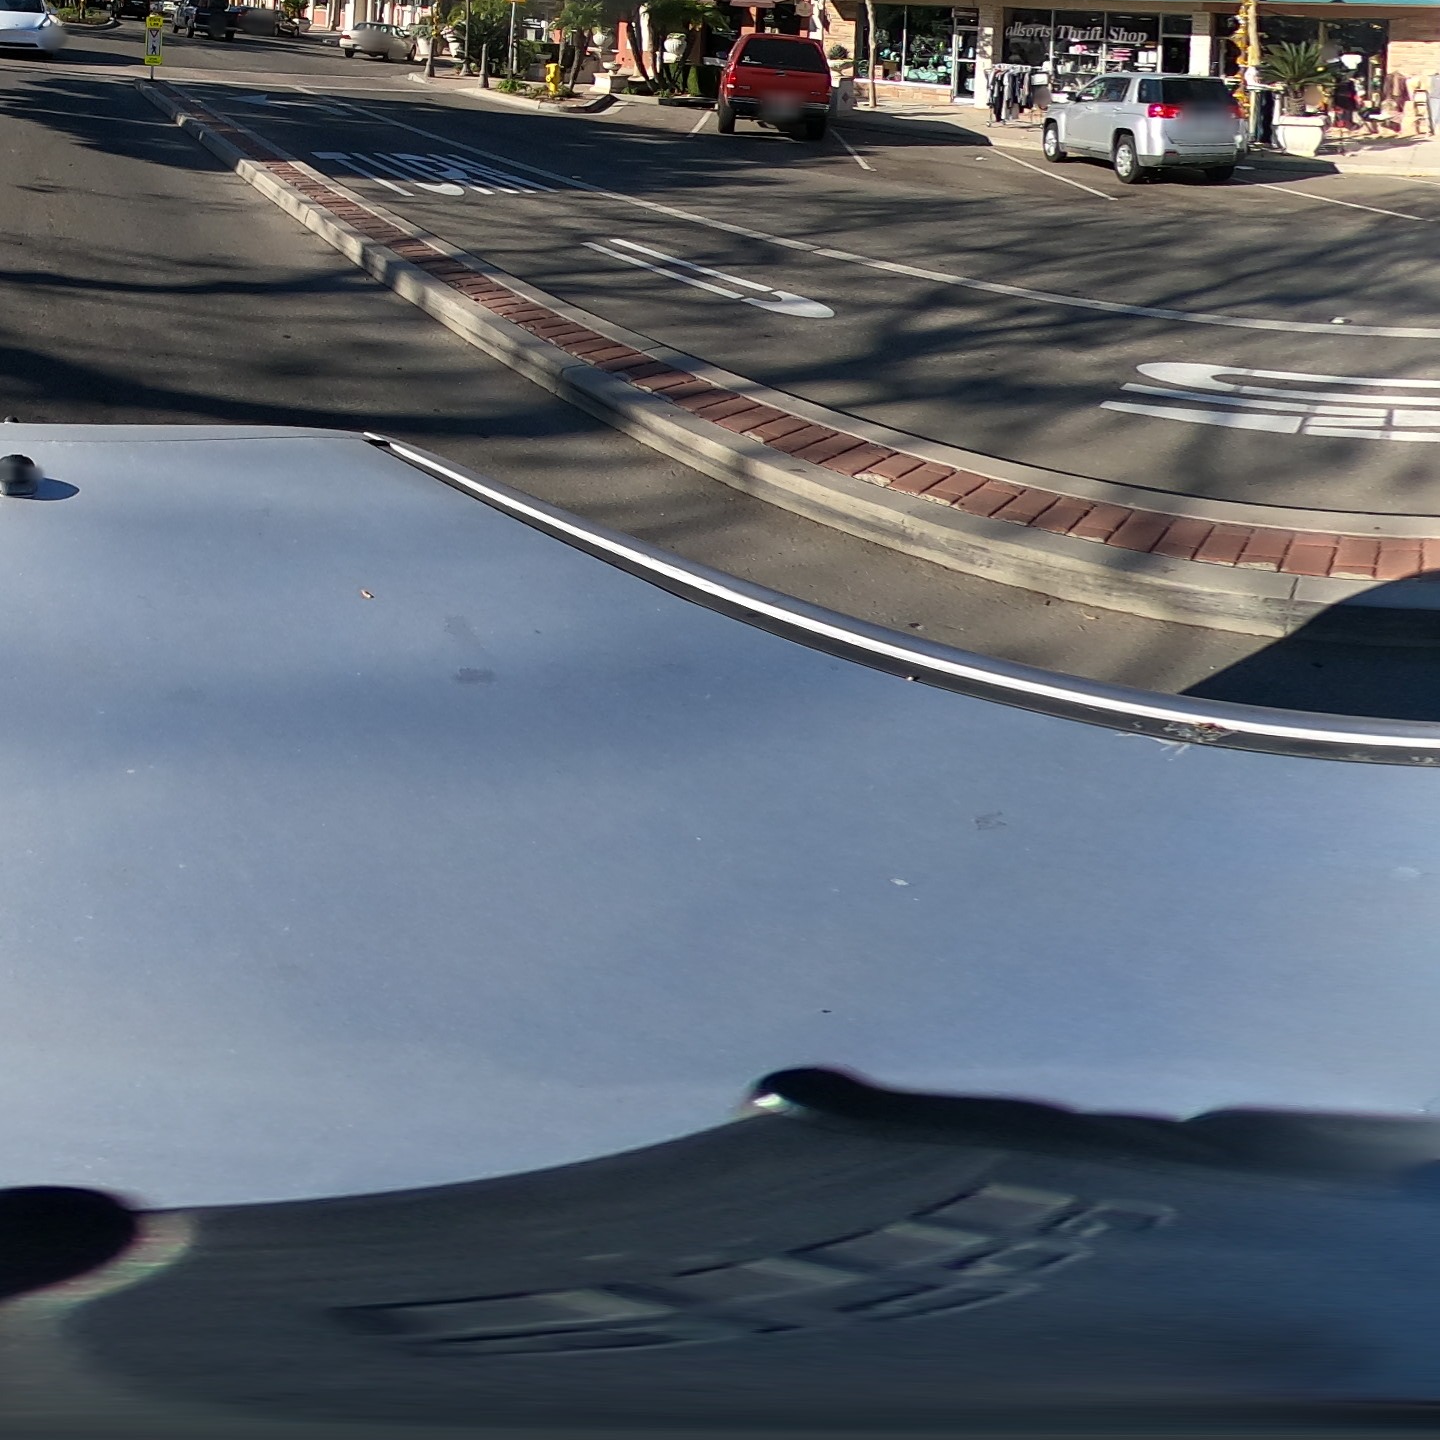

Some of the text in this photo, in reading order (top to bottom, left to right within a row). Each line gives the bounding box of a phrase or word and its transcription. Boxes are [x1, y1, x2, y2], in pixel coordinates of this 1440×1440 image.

[1005, 22, 1148, 46] allsorts Thrift Shop
